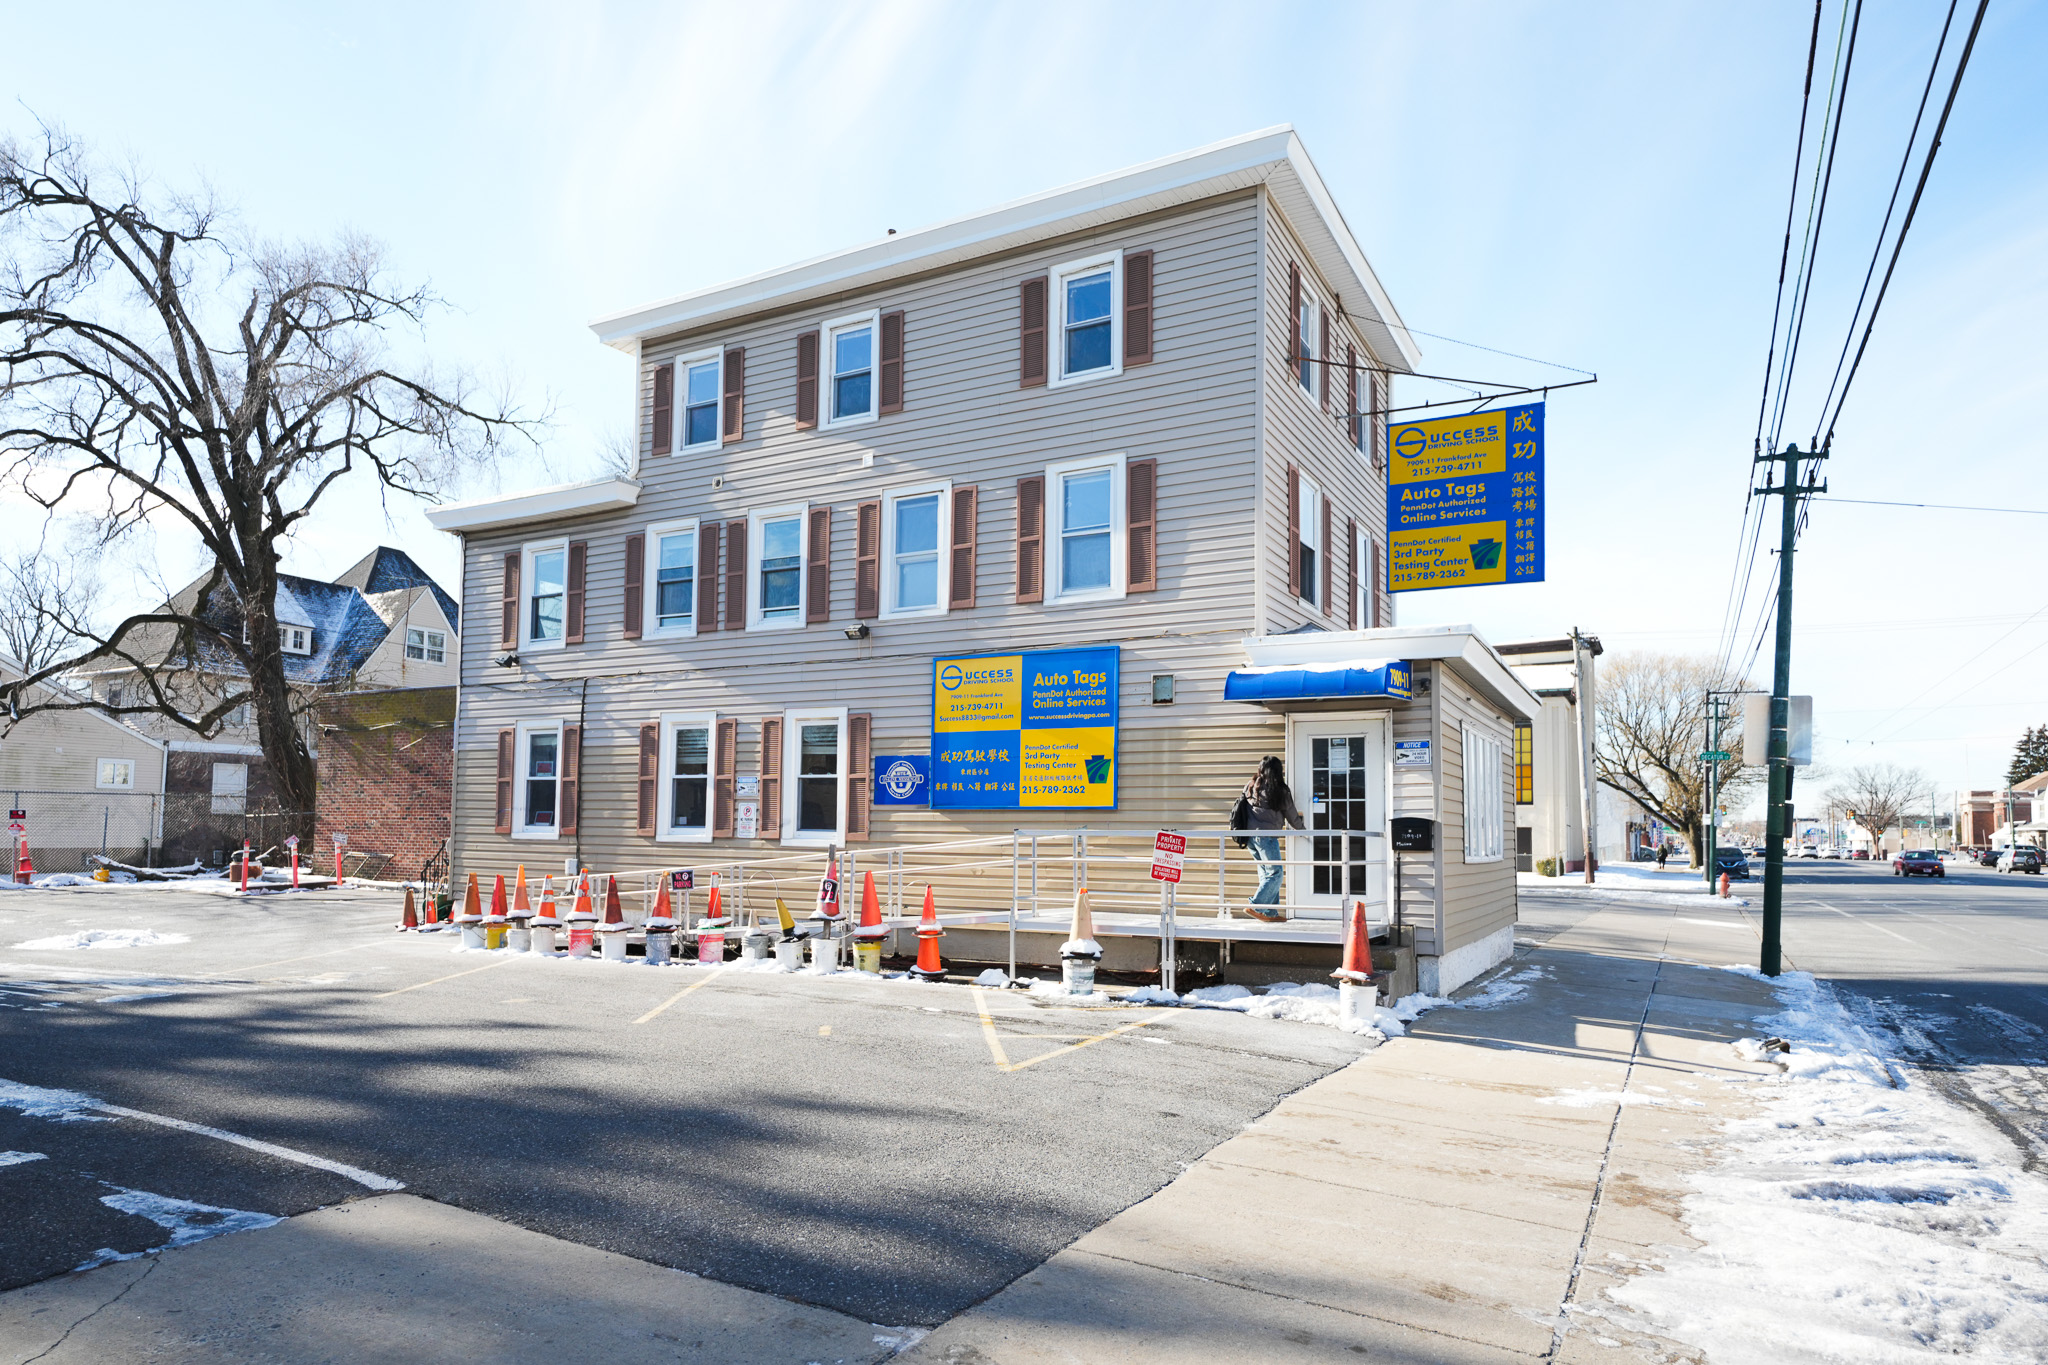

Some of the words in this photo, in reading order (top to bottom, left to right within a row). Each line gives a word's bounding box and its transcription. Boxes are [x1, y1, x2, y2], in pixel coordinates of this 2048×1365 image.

[1512, 410, 1536, 459] 成功
[1428, 440, 1462, 450] DRIVING
[1466, 436, 1500, 444] SCHOOL
[1406, 458, 1435, 467] 7909-11
[1437, 454, 1472, 463] Frankford
[1412, 461, 1482, 476] 215-739-4711
[1401, 487, 1441, 502] Auto
[1446, 482, 1486, 497] Tags
[1400, 502, 1436, 512] PennDot
[1438, 496, 1486, 508] Authorized
[1400, 511, 1436, 523] Online
[1440, 508, 1486, 520] Services
[1394, 540, 1426, 548] PennDot
[1428, 535, 1462, 545] Certified
[1394, 549, 1412, 559] 3rd
[1416, 548, 1444, 558] Party
[1394, 559, 1430, 570] Testing
[1433, 557, 1469, 567] Center
[1394, 568, 1466, 582] 215-789-2362
[1033, 672, 1068, 686] Auto
[1072, 670, 1106, 687] Tags
[1390, 668, 1409, 688] 7909-11
[1032, 690, 1064, 698] PennDot
[1065, 686, 1106, 696] Authorized
[950, 702, 1003, 712] 215-739-4711
[1032, 698, 1064, 708] Online
[1066, 696, 1106, 707] Services
[1040, 752, 1060, 760] Party
[1024, 762, 1050, 770] Testing
[1022, 786, 1086, 794] 215-789-2362
[1156, 842, 1184, 852] PROPERTY
[1160, 836, 1182, 846] PRIVATE
[1154, 857, 1182, 868] TRESPASSING
